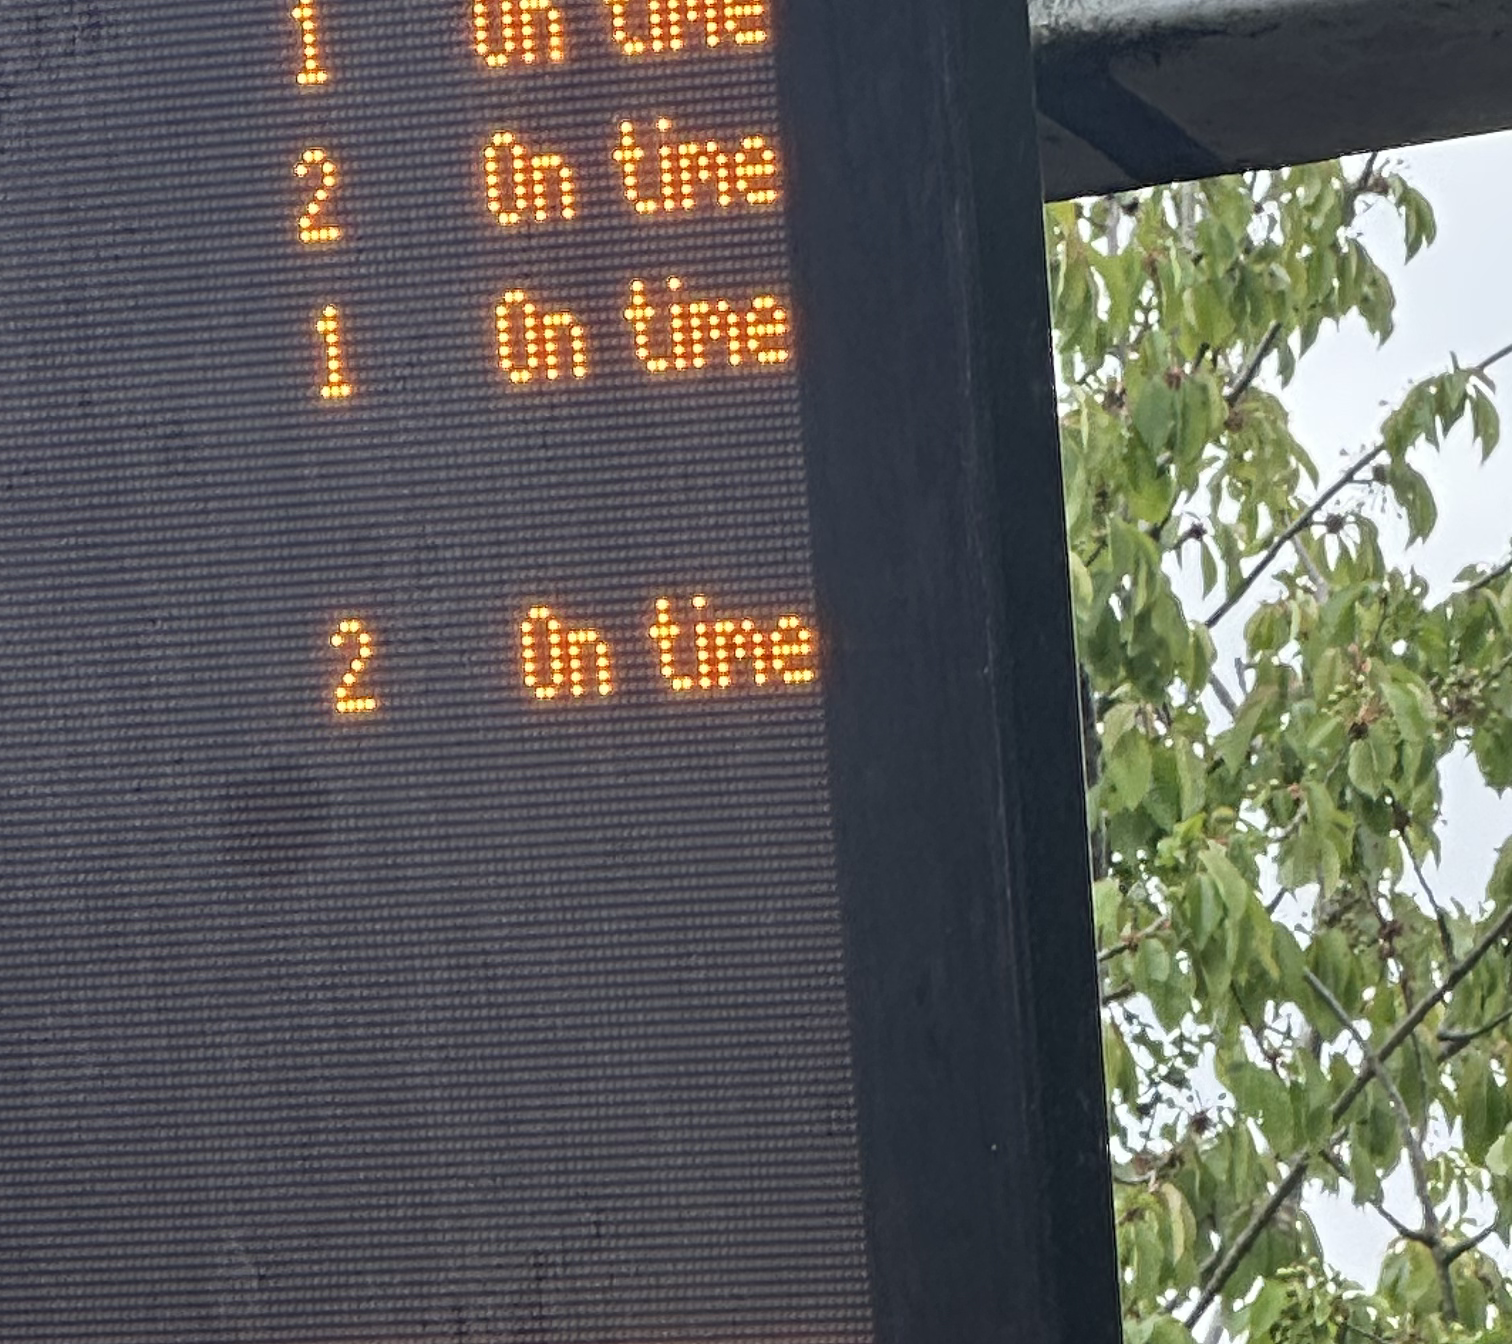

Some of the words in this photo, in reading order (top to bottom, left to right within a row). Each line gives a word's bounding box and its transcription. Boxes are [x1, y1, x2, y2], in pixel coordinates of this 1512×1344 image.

[294, 147, 343, 244] 2
[484, 130, 576, 226] On
[613, 117, 780, 214] time
[317, 304, 353, 399] 1
[494, 288, 588, 384] On
[624, 276, 791, 371] time
[329, 619, 377, 713] 2
[520, 604, 613, 700] On
[649, 593, 815, 691] time
